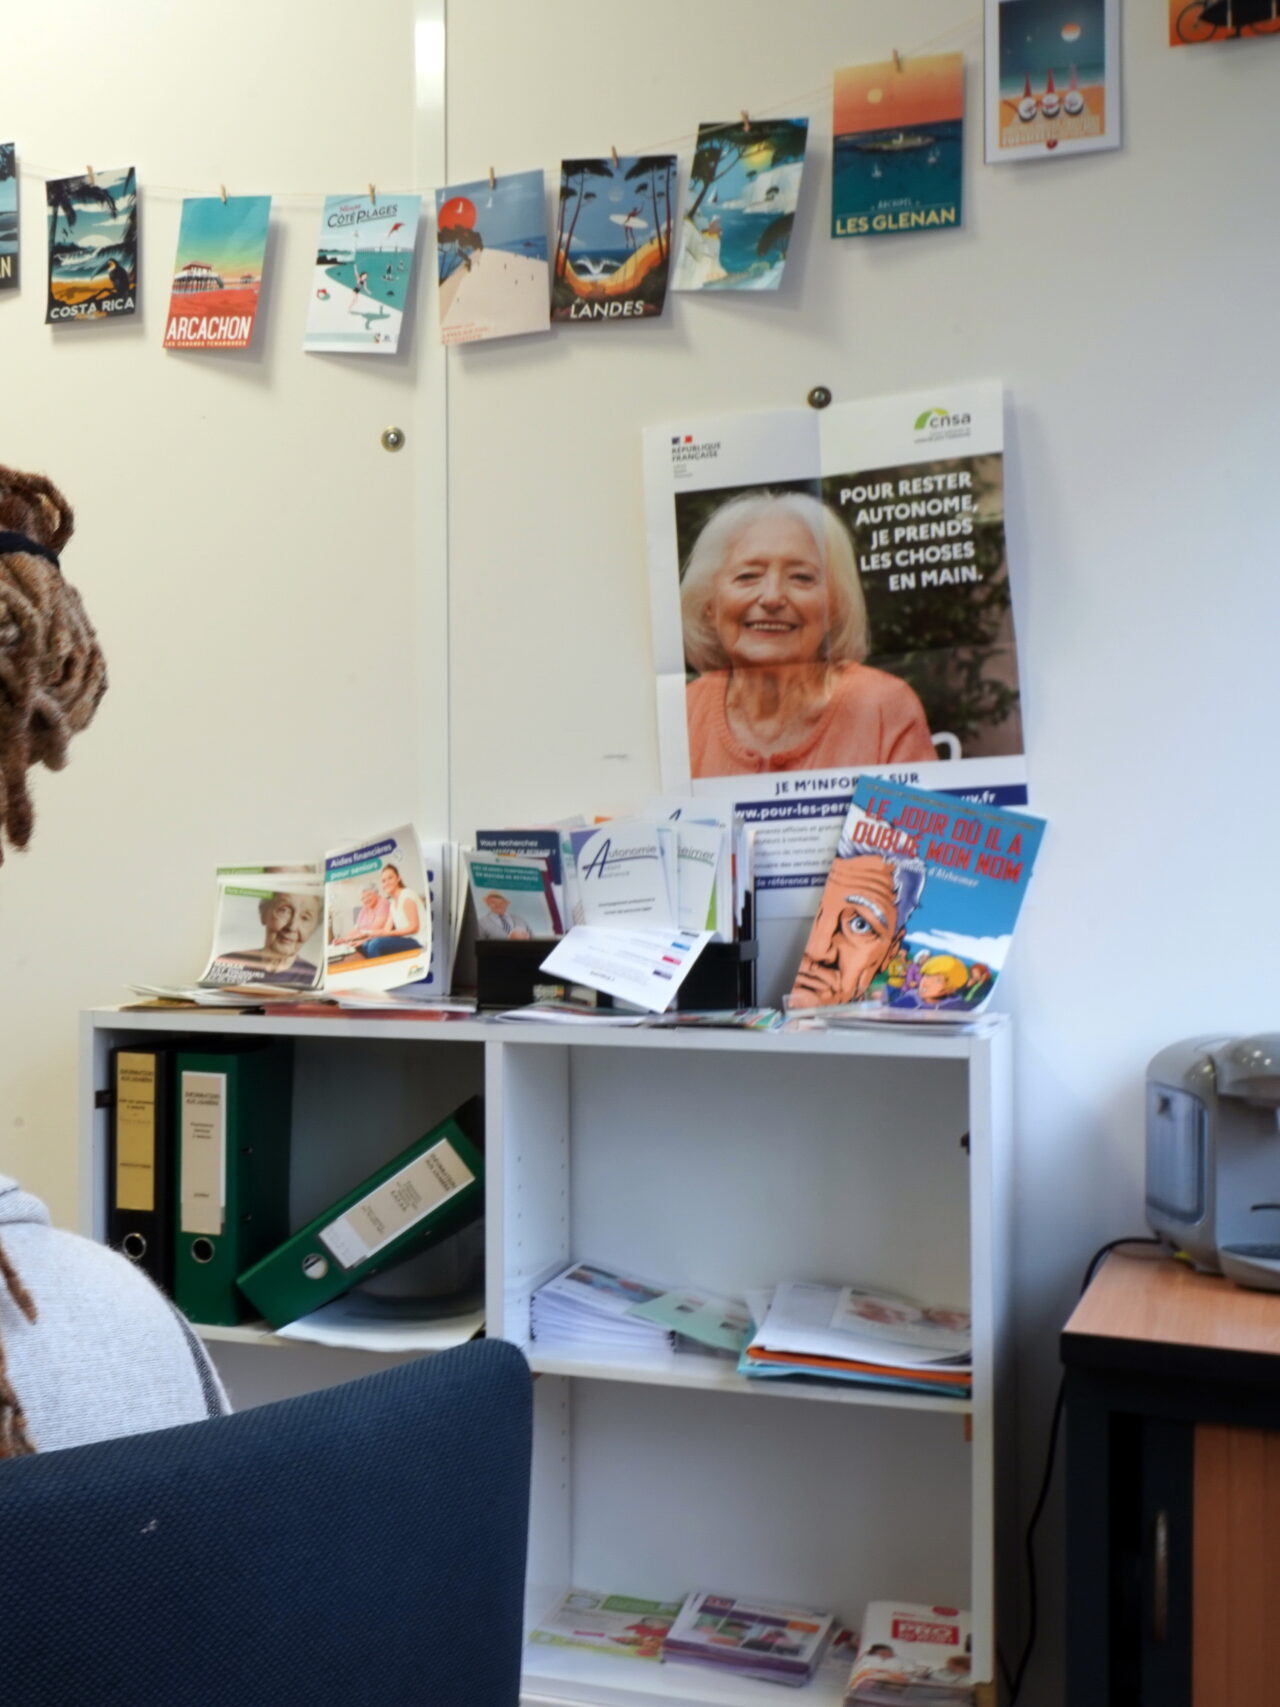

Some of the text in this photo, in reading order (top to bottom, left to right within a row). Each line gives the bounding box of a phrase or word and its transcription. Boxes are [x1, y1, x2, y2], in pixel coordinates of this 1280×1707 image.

[836, 206, 956, 235] LES GLENAN
[50, 302, 97, 318] COSTA
[102, 297, 134, 311] RICA
[570, 300, 644, 319] LANDES
[166, 316, 252, 340] ARCACHON
[929, 413, 971, 429] cnsa
[840, 471, 972, 505] POUR RESTER
[856, 494, 978, 526] AUTONOME,
[871, 518, 973, 550] JE PRENDS
[860, 541, 975, 572] LES CHOSES
[889, 565, 983, 592] EN MAIN.
[775, 781, 789, 795] JE
[889, 773, 920, 785] SUR
[866, 797, 891, 821] LE
[893, 805, 949, 836] JOUR
[985, 827, 1001, 853] IL
[1007, 833, 1022, 857] A
[330, 856, 353, 868] Aides
[582, 838, 658, 880] Autonomie
[925, 840, 972, 871] MON
[975, 852, 1023, 884] NOM
